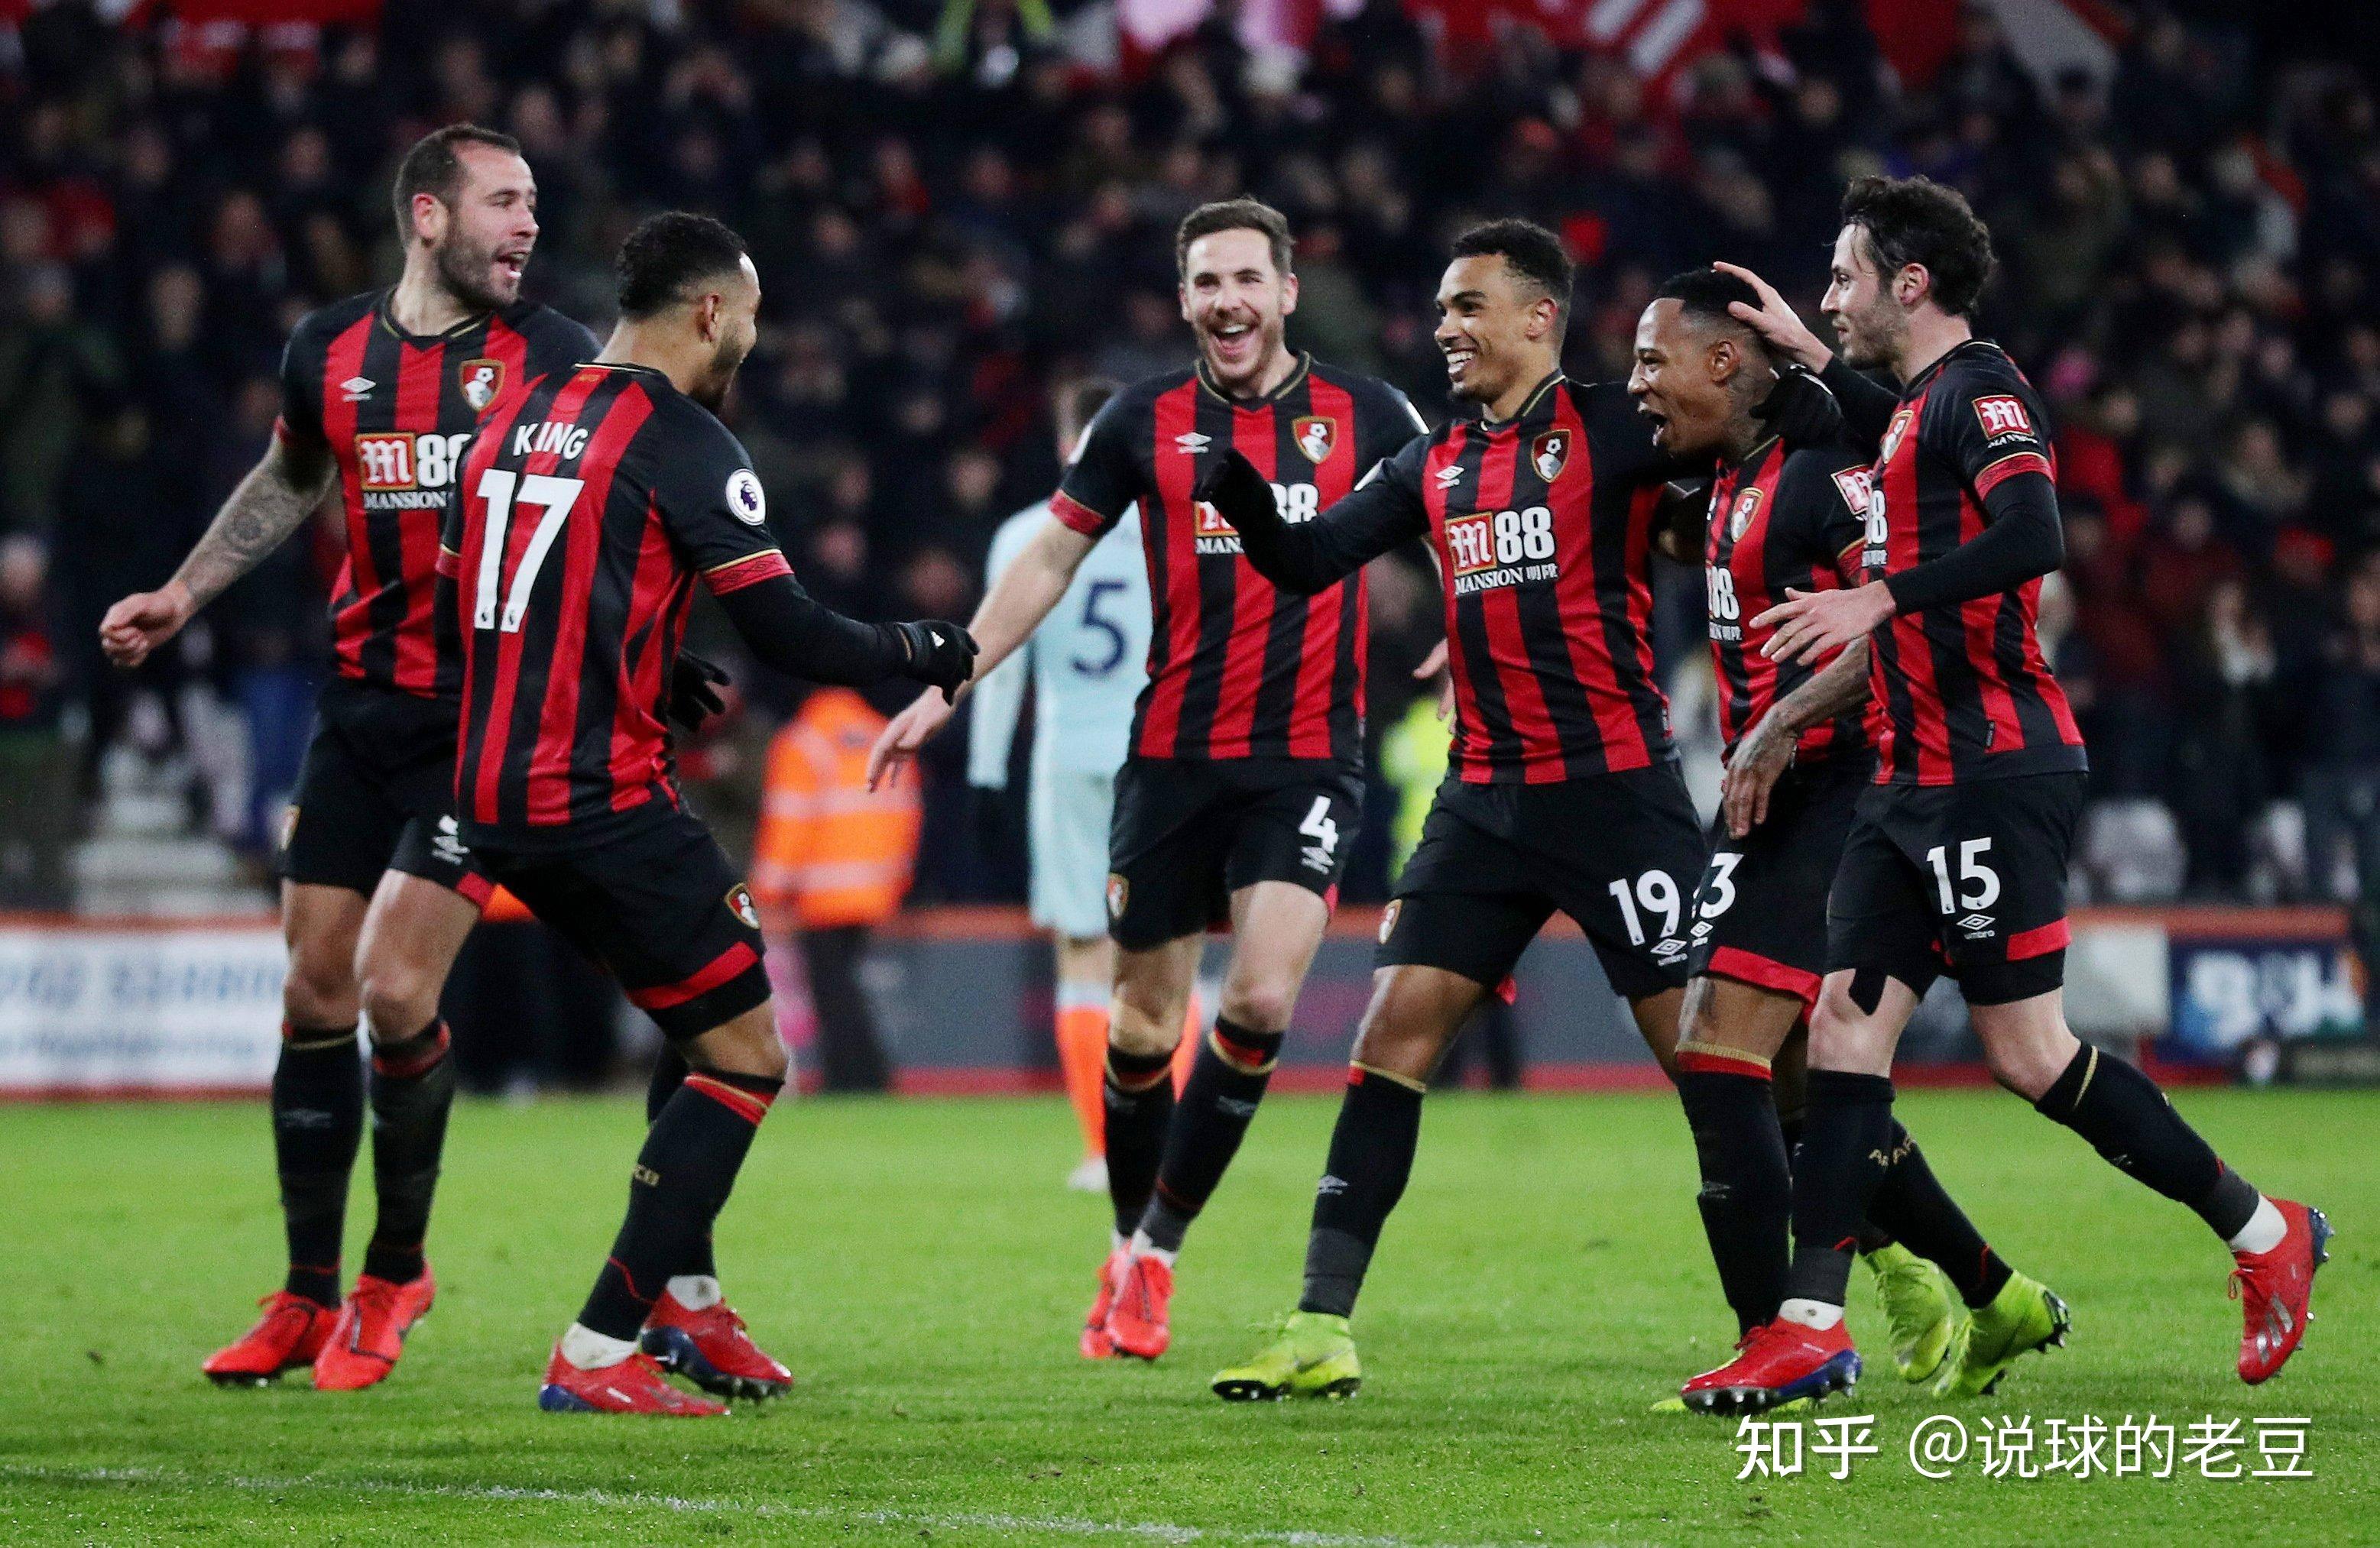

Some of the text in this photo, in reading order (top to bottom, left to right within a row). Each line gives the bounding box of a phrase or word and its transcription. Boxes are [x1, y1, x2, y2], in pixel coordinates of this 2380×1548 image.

[513, 421, 589, 460] KING
[474, 468, 585, 633] 17
[1195, 536, 1245, 555] MAN
[1454, 567, 1524, 595] MANSION
[1072, 578, 1127, 678] 5
[1299, 795, 1338, 853] 4
[1609, 869, 1681, 947] 19
[1691, 852, 1744, 918] 3
[1926, 836, 2001, 915] 15
